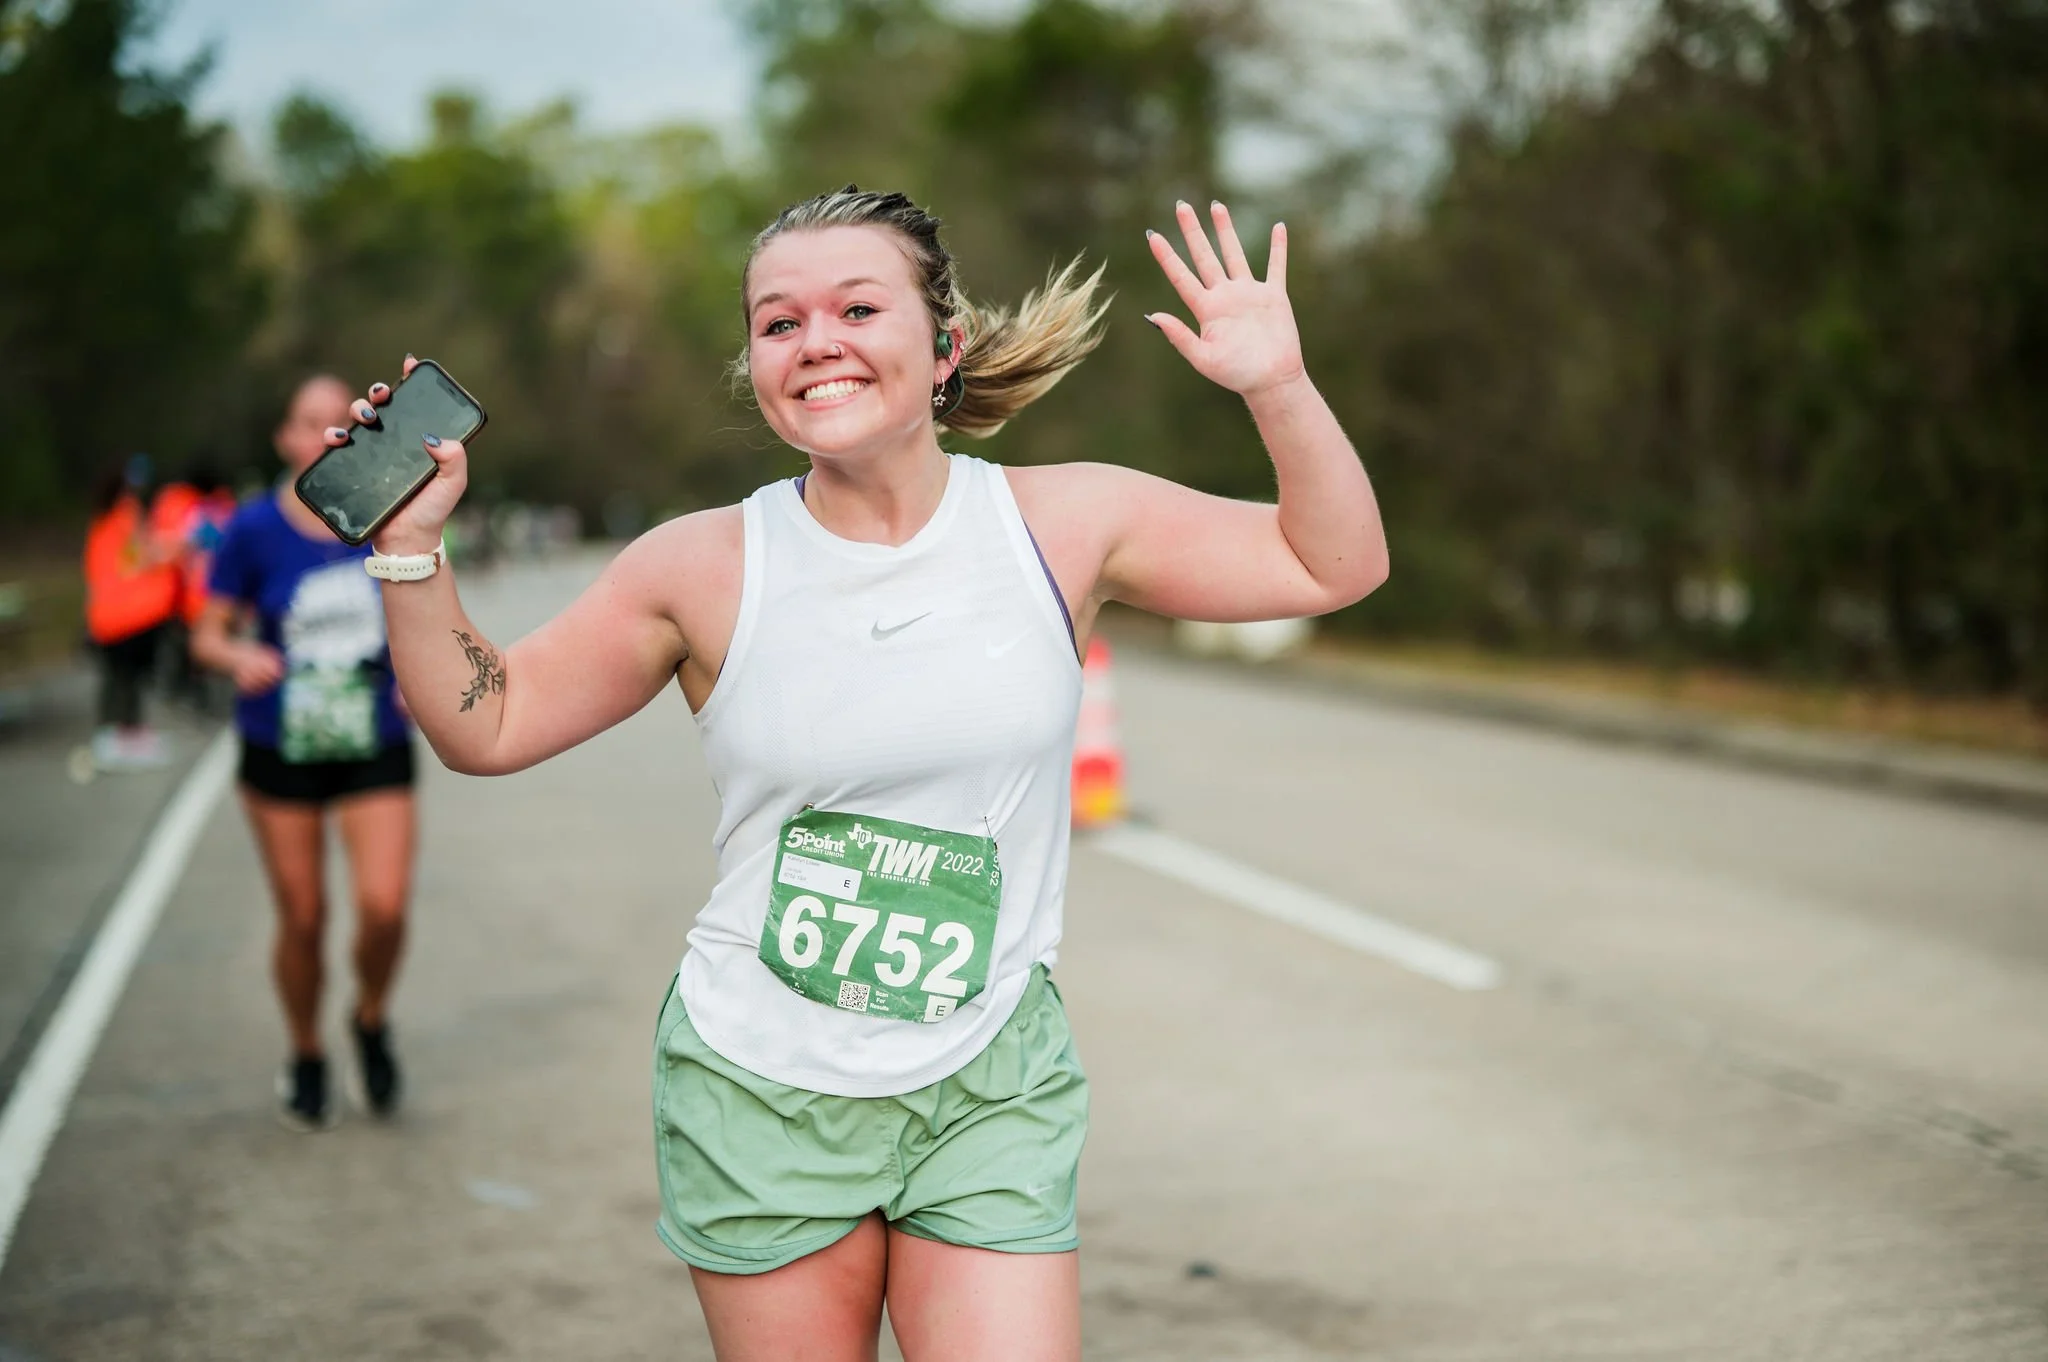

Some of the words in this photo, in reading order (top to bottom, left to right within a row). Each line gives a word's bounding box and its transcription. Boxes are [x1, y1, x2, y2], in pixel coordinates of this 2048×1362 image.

[857, 831, 866, 844] 10
[823, 850, 845, 859] UNION
[867, 834, 940, 881] TWM
[941, 852, 984, 876] 2022
[843, 880, 851, 889] E
[778, 895, 975, 998] 6752
[876, 990, 889, 998] Scan
[870, 1003, 889, 1011] Results
[936, 1005, 946, 1016] E
